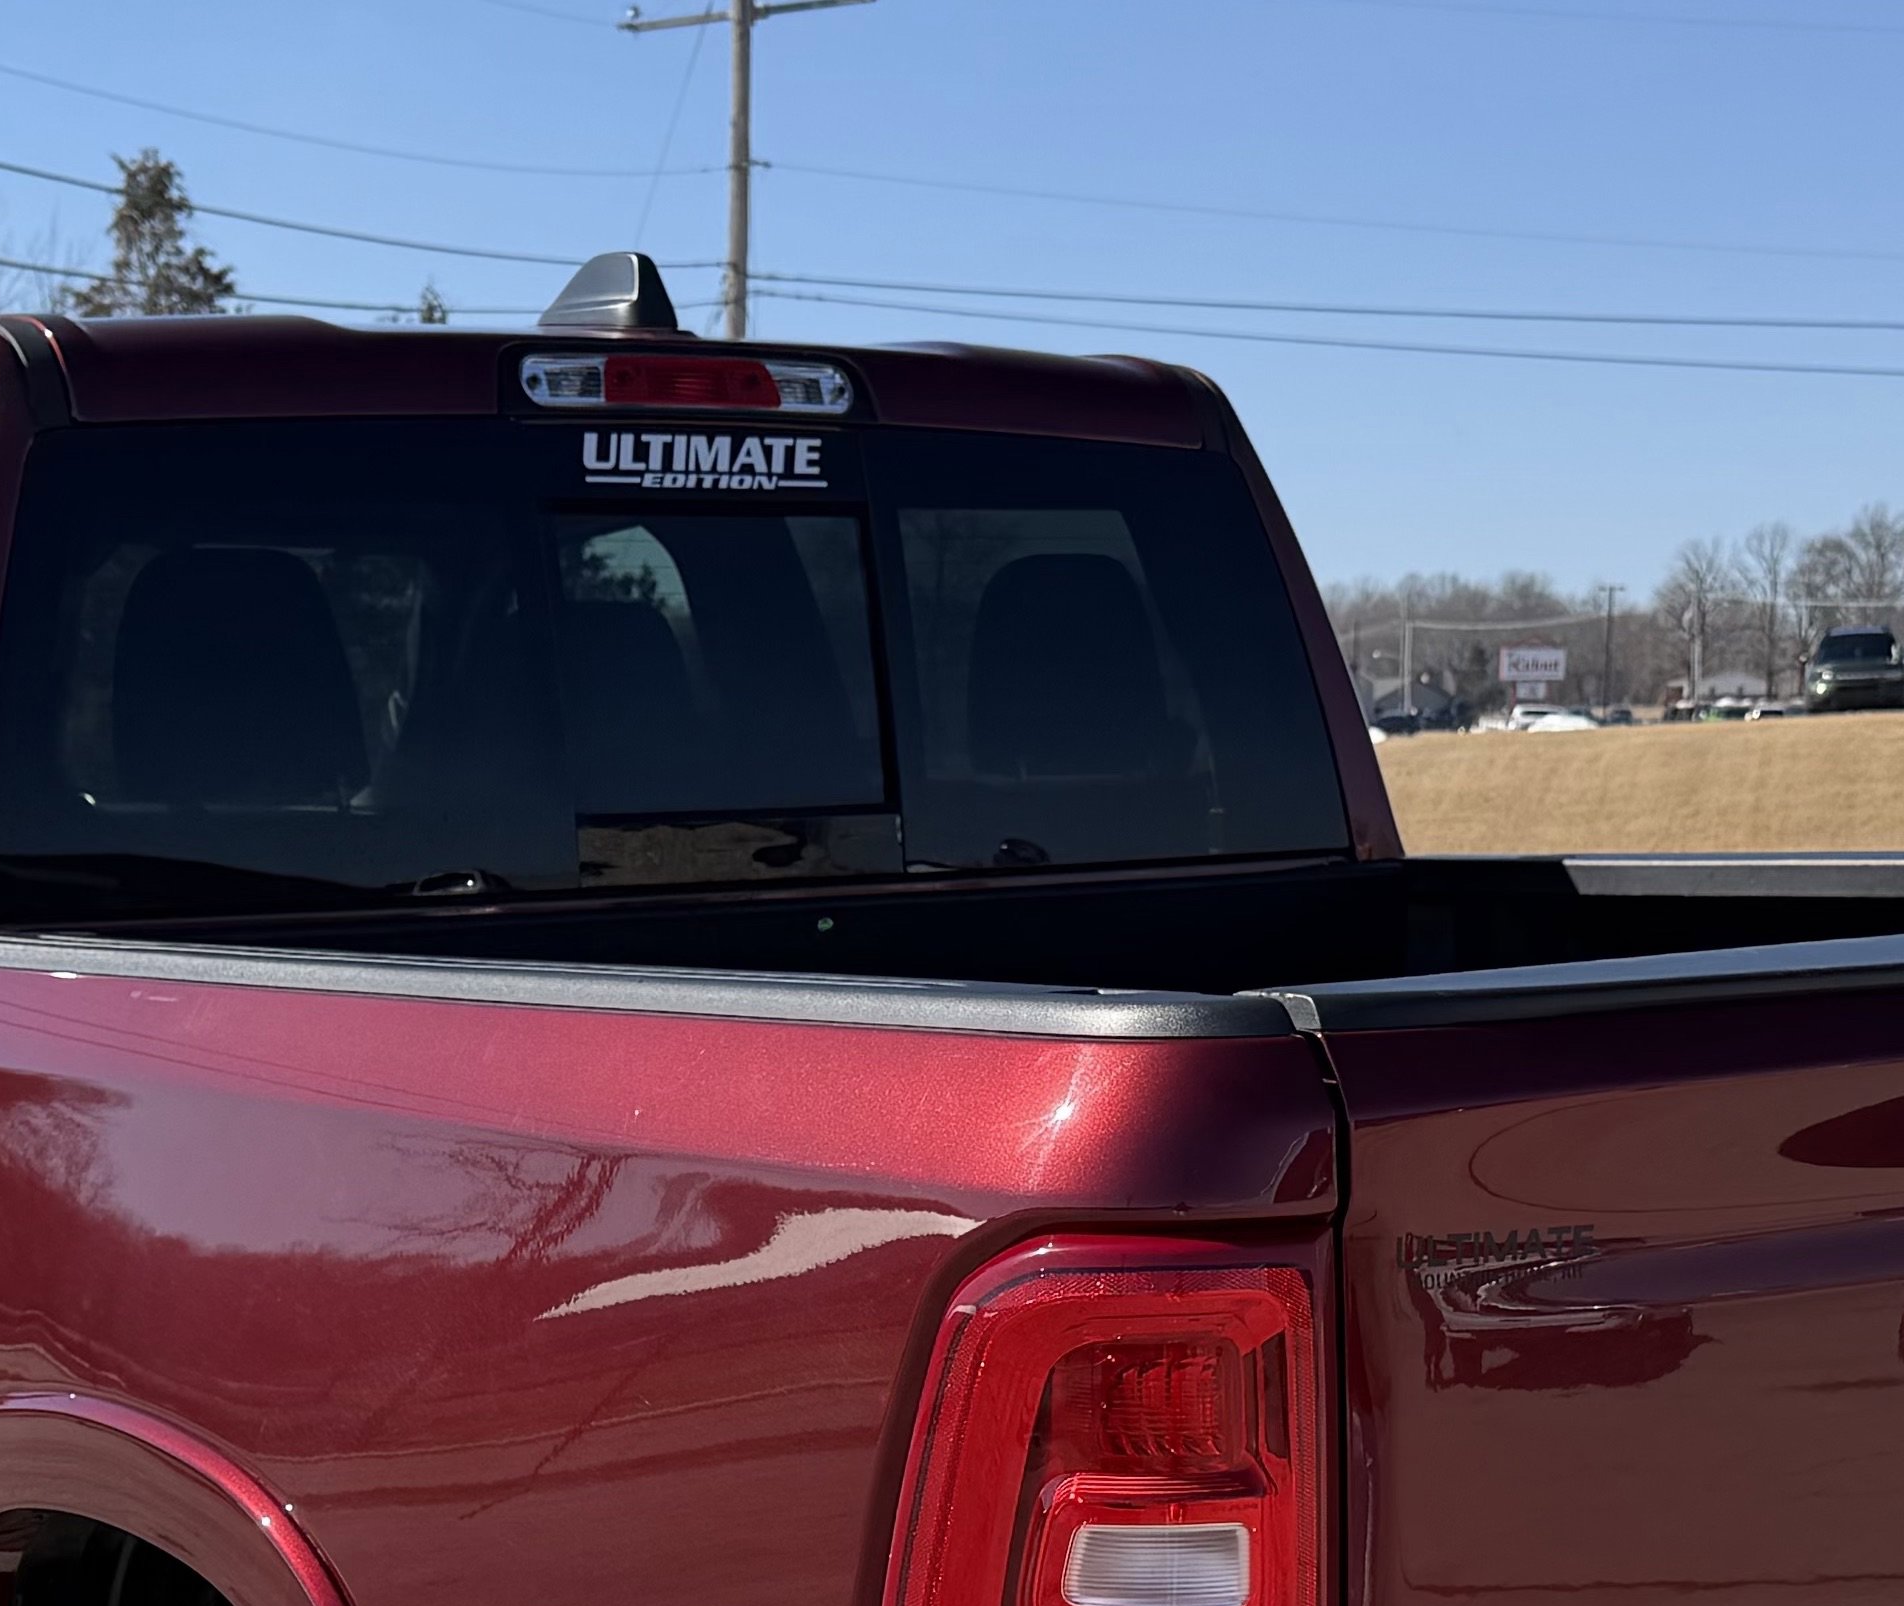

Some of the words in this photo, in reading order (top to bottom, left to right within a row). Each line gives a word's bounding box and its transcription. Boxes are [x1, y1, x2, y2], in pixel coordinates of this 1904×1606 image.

[582, 431, 823, 475] ULTIMATE
[641, 472, 779, 491] EDITION
[1396, 1224, 1595, 1269] ULTIMATE
